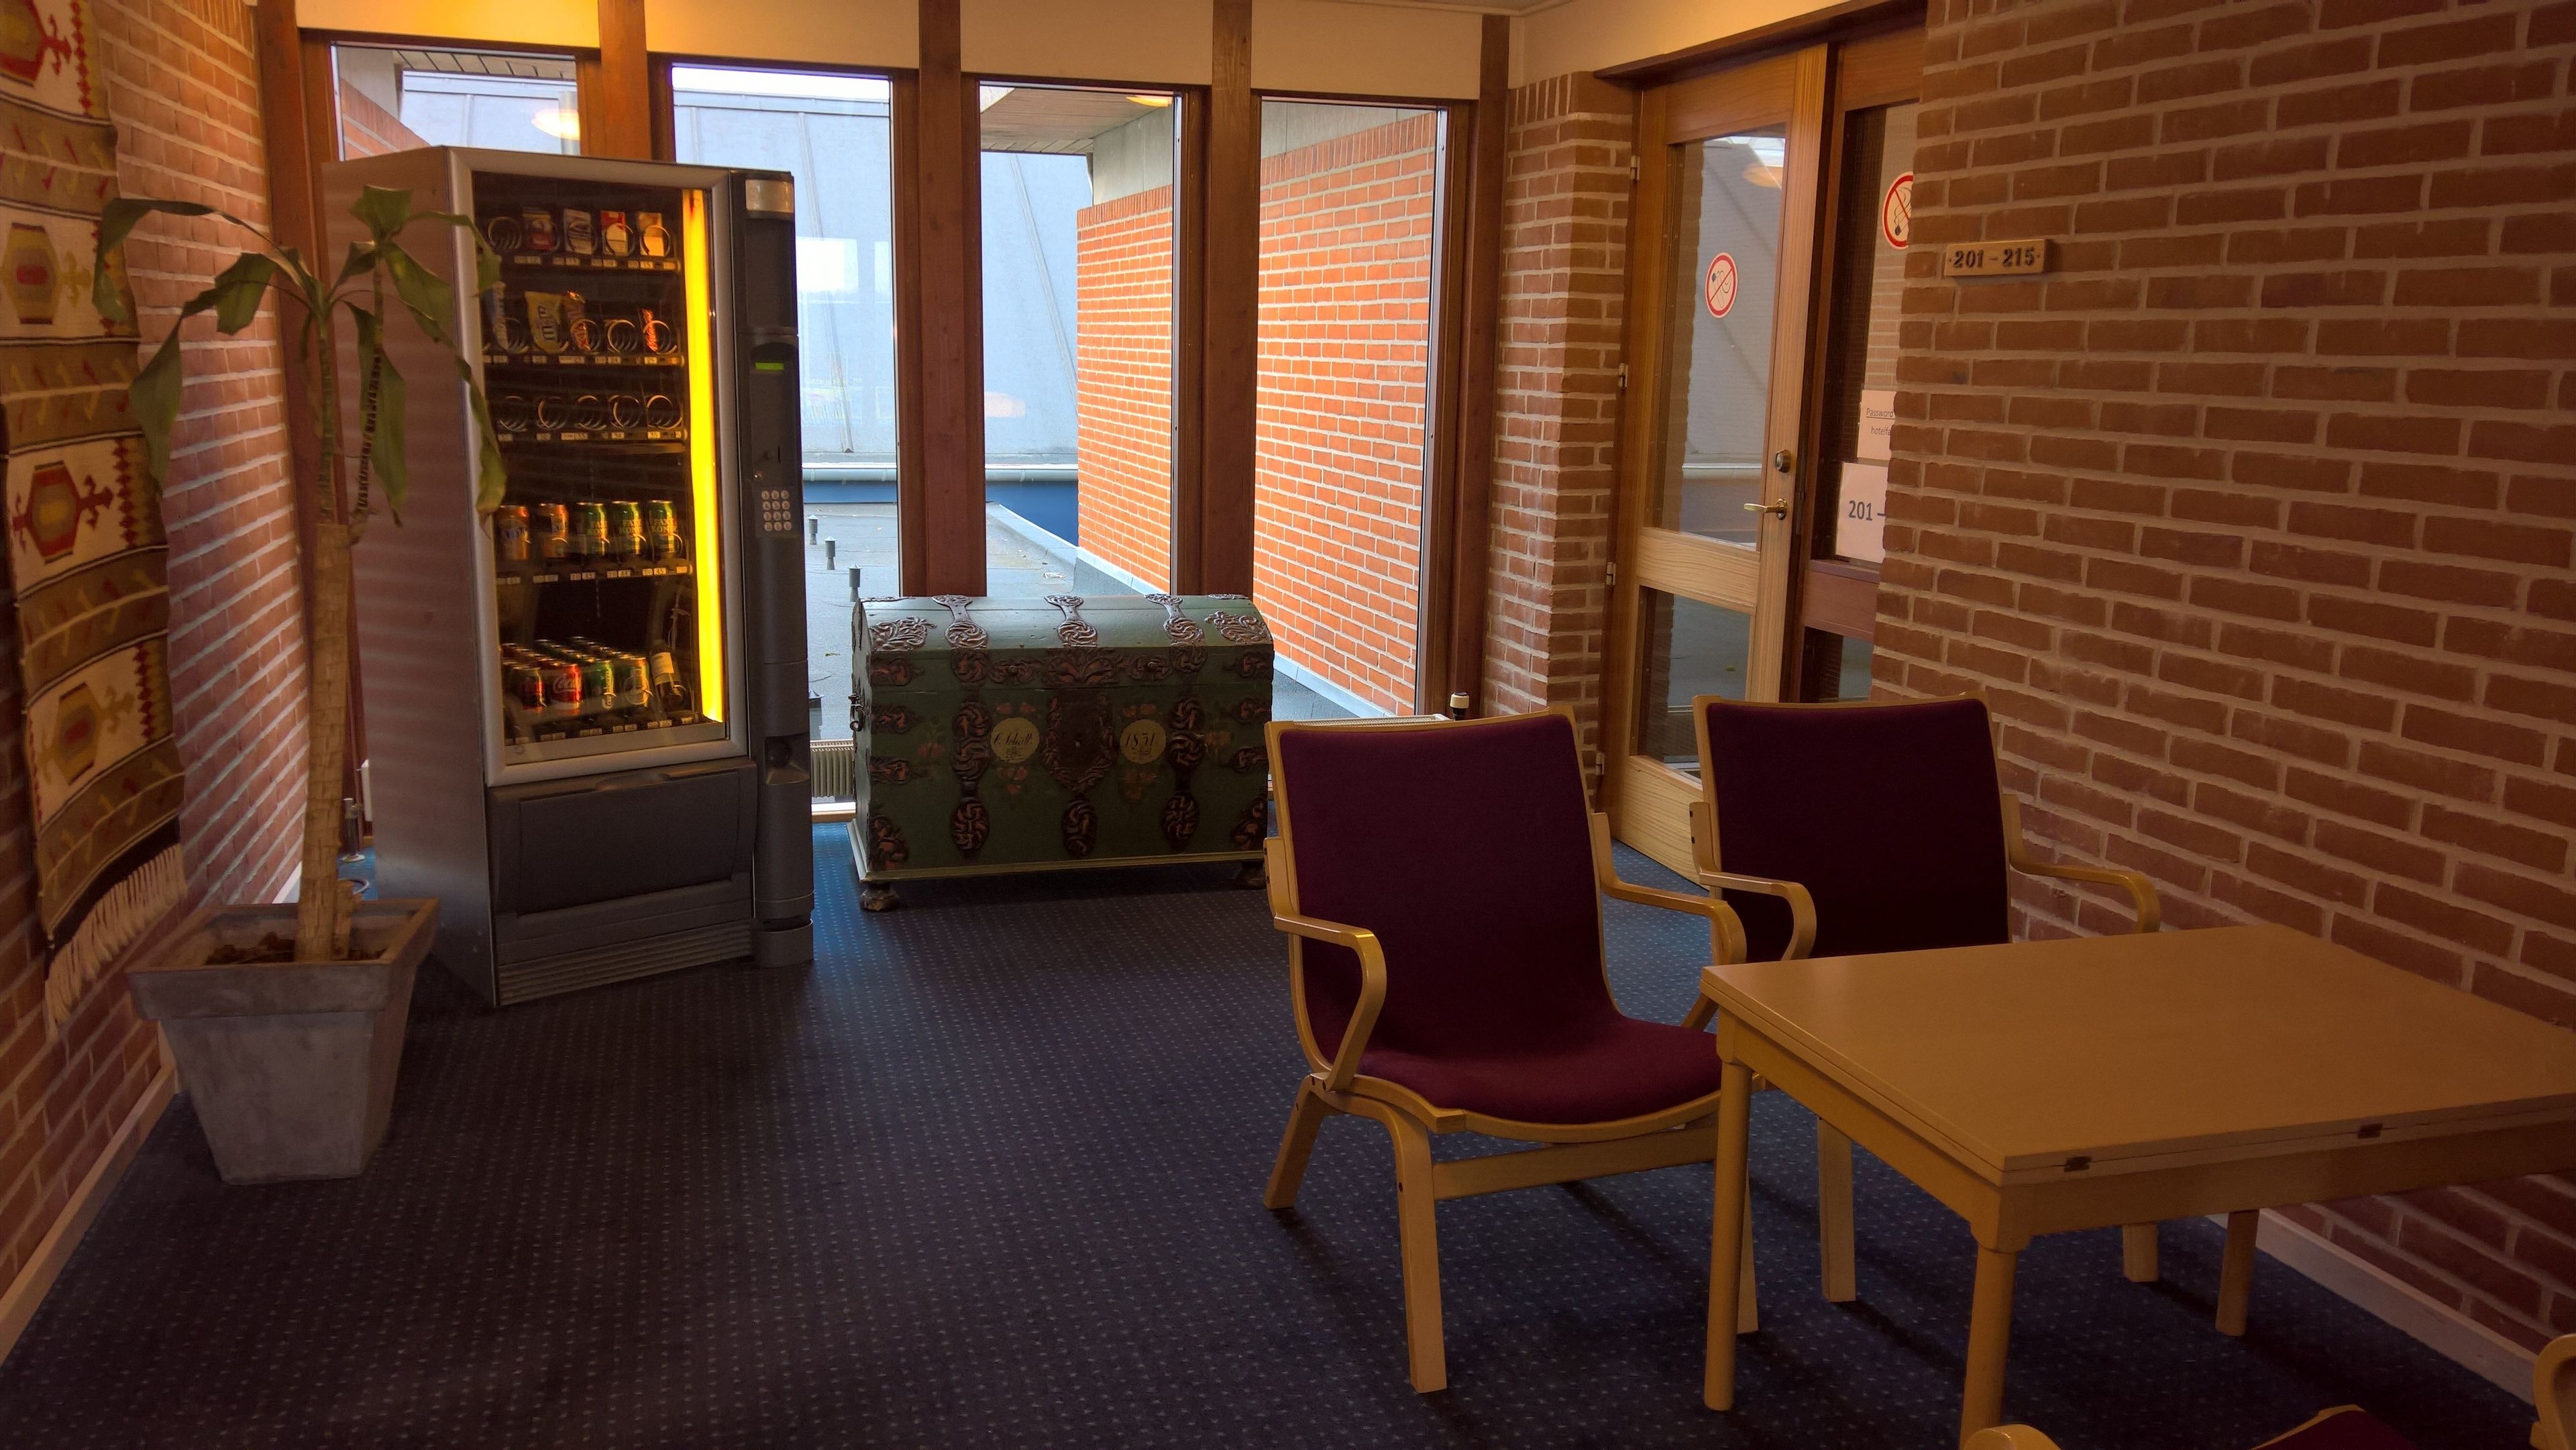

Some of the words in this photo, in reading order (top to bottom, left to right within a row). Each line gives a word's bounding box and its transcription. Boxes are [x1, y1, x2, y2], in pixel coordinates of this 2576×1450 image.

[1953, 249, 1984, 268] 201
[2002, 247, 2035, 268] 215
[1866, 407, 1894, 417] Password
[1848, 500, 1873, 521] 201
